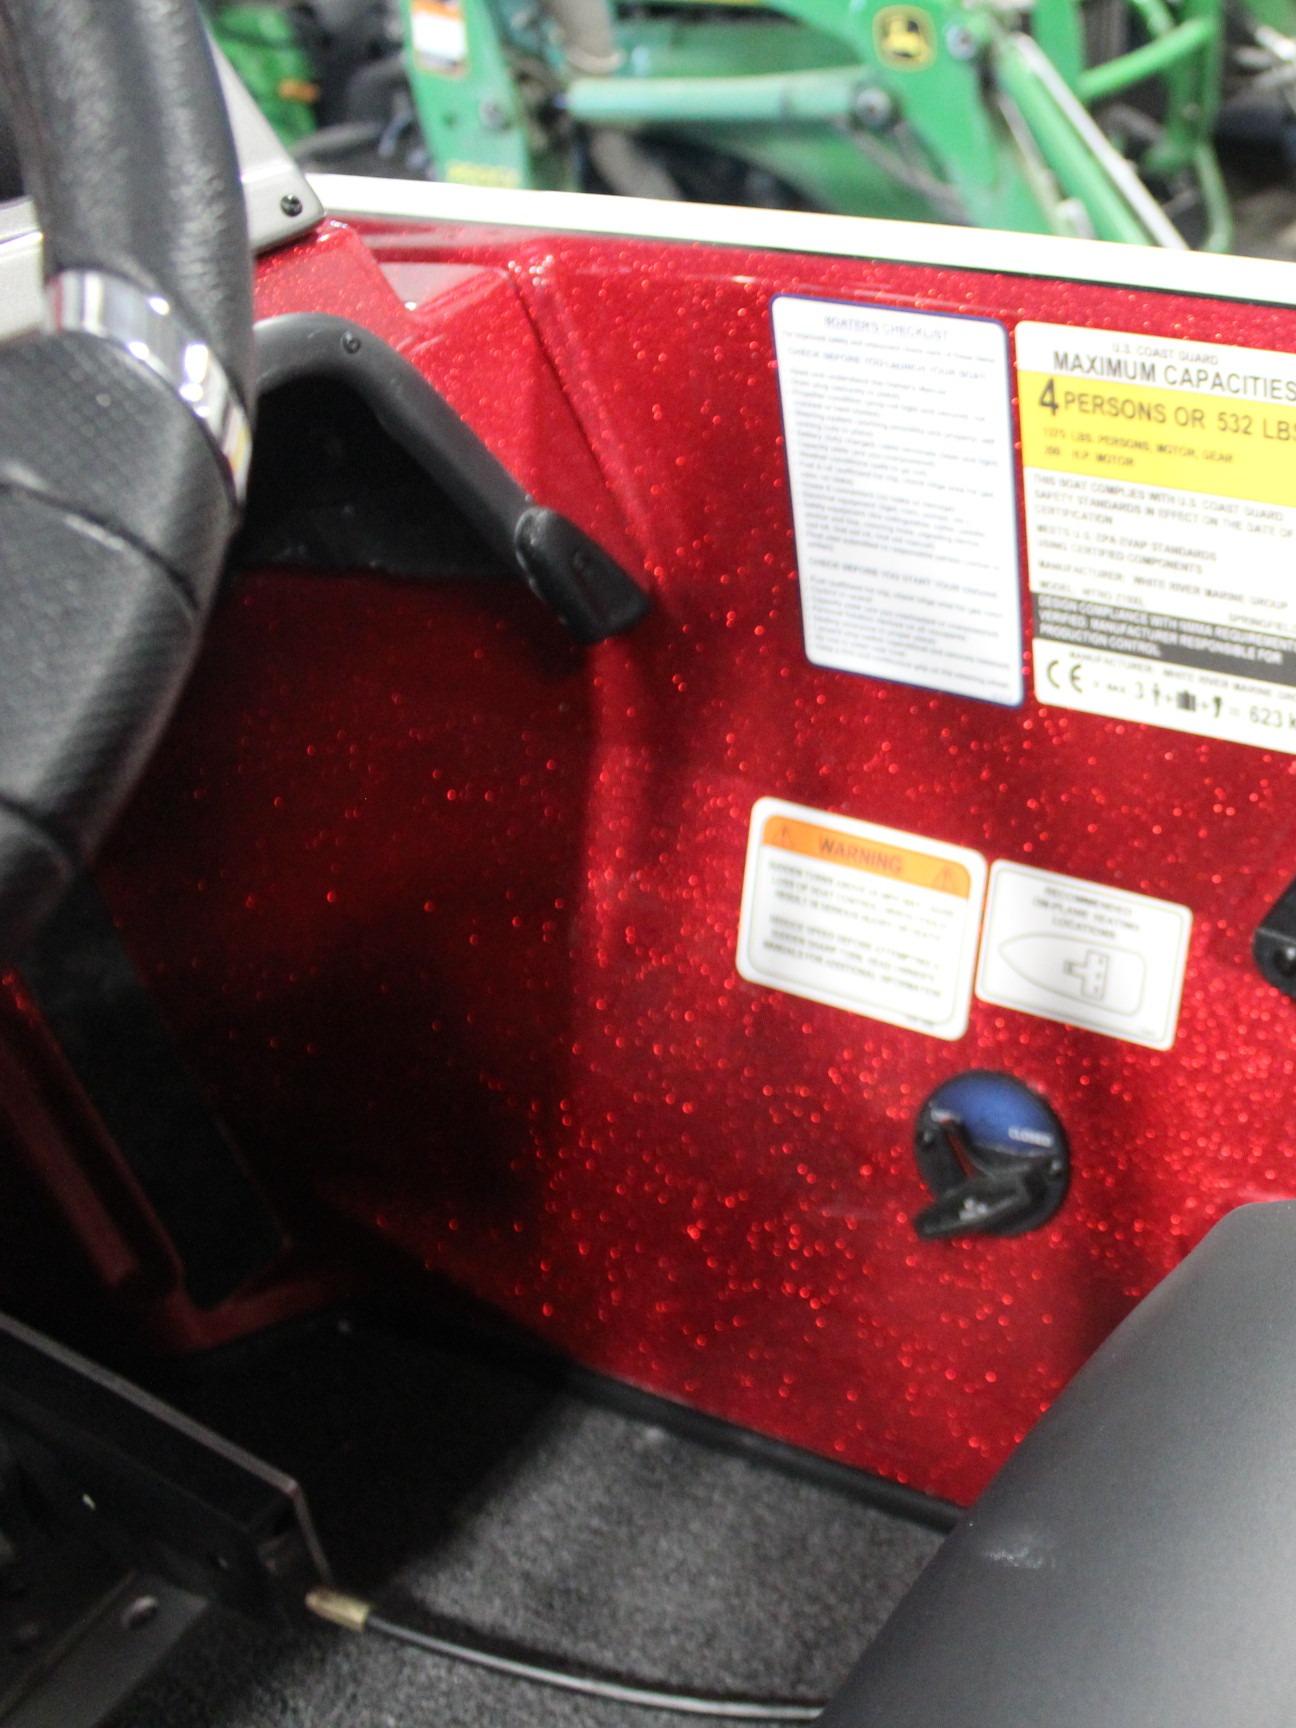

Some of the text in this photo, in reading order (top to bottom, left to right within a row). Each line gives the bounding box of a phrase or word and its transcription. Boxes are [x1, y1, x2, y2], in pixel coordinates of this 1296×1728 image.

[1053, 351, 1156, 382] MAXIMUM
[1137, 346, 1173, 360] COAST
[1038, 377, 1059, 417] 4
[1064, 391, 1166, 424] PERSONS
[1174, 406, 1205, 429] OR
[1217, 412, 1252, 436] 532
[1250, 705, 1282, 728] 623
[818, 836, 903, 874] WARNING
